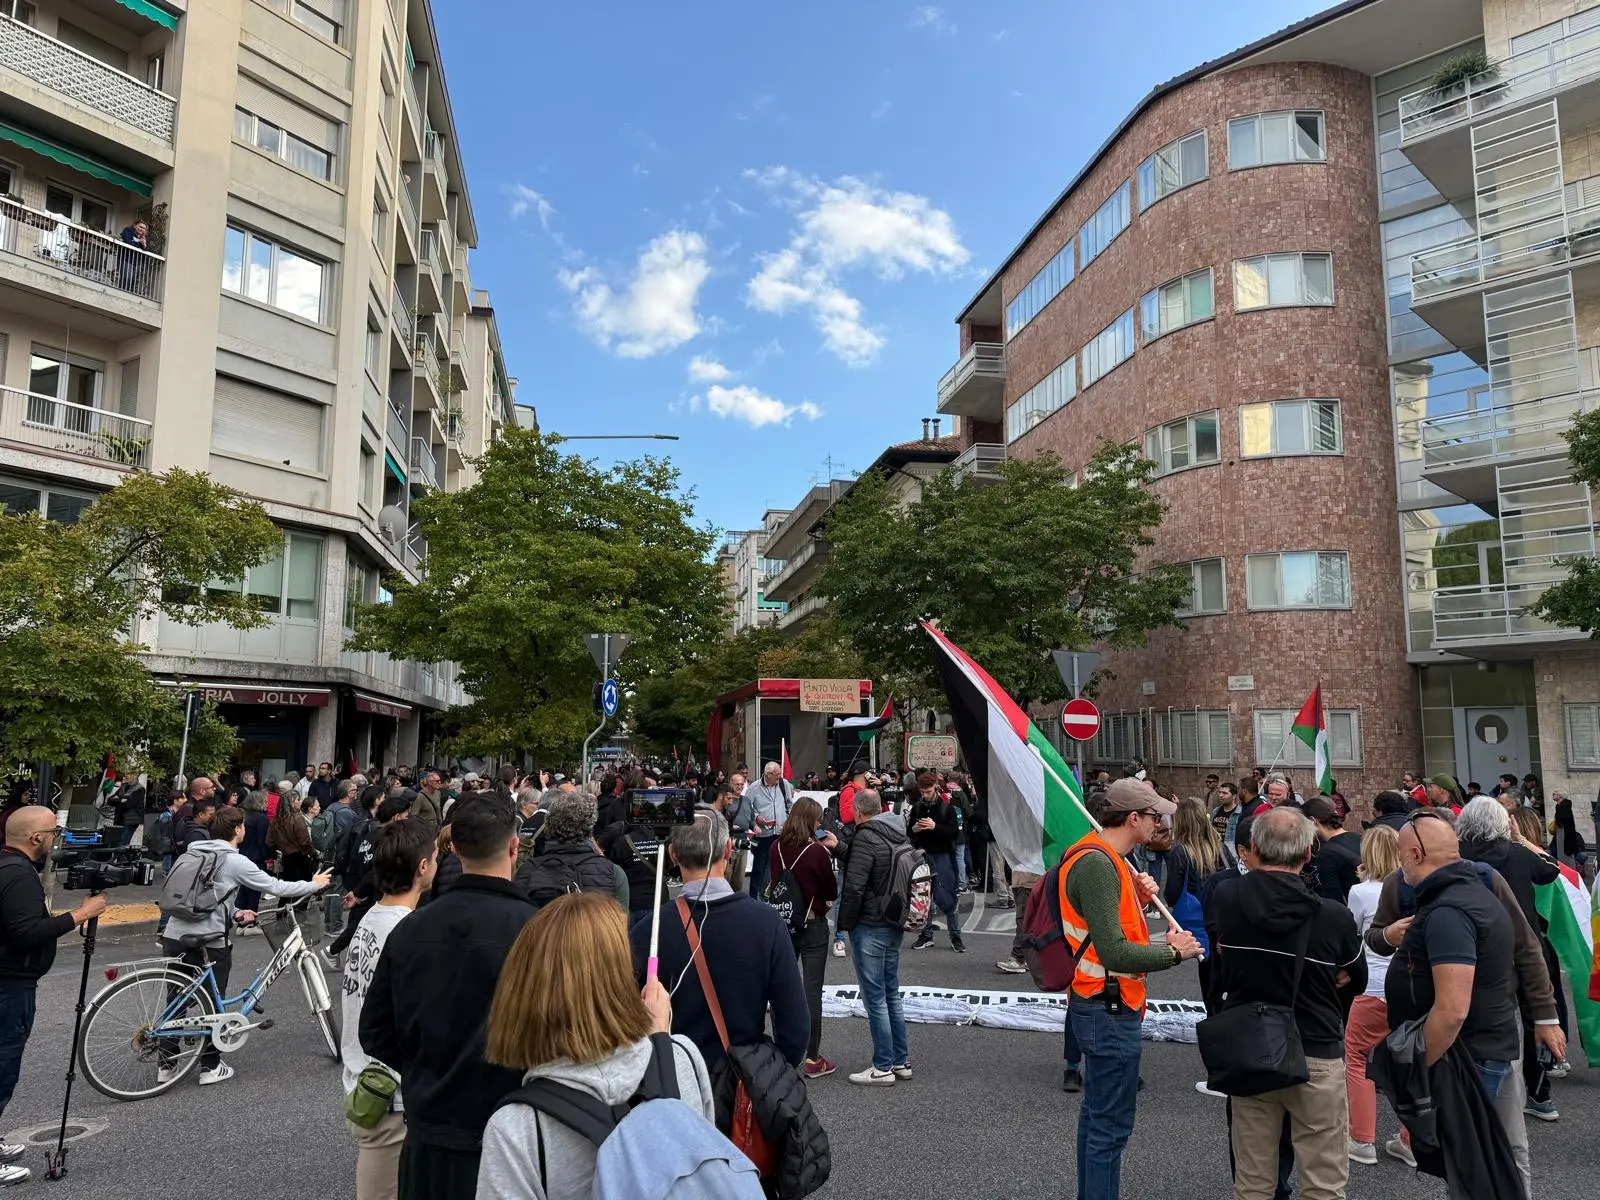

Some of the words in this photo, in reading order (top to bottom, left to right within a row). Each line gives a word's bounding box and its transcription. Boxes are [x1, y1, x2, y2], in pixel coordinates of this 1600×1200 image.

[803, 680, 828, 693] PUNTO
[830, 683, 853, 693] VIOLA
[257, 691, 308, 705] JOLLY
